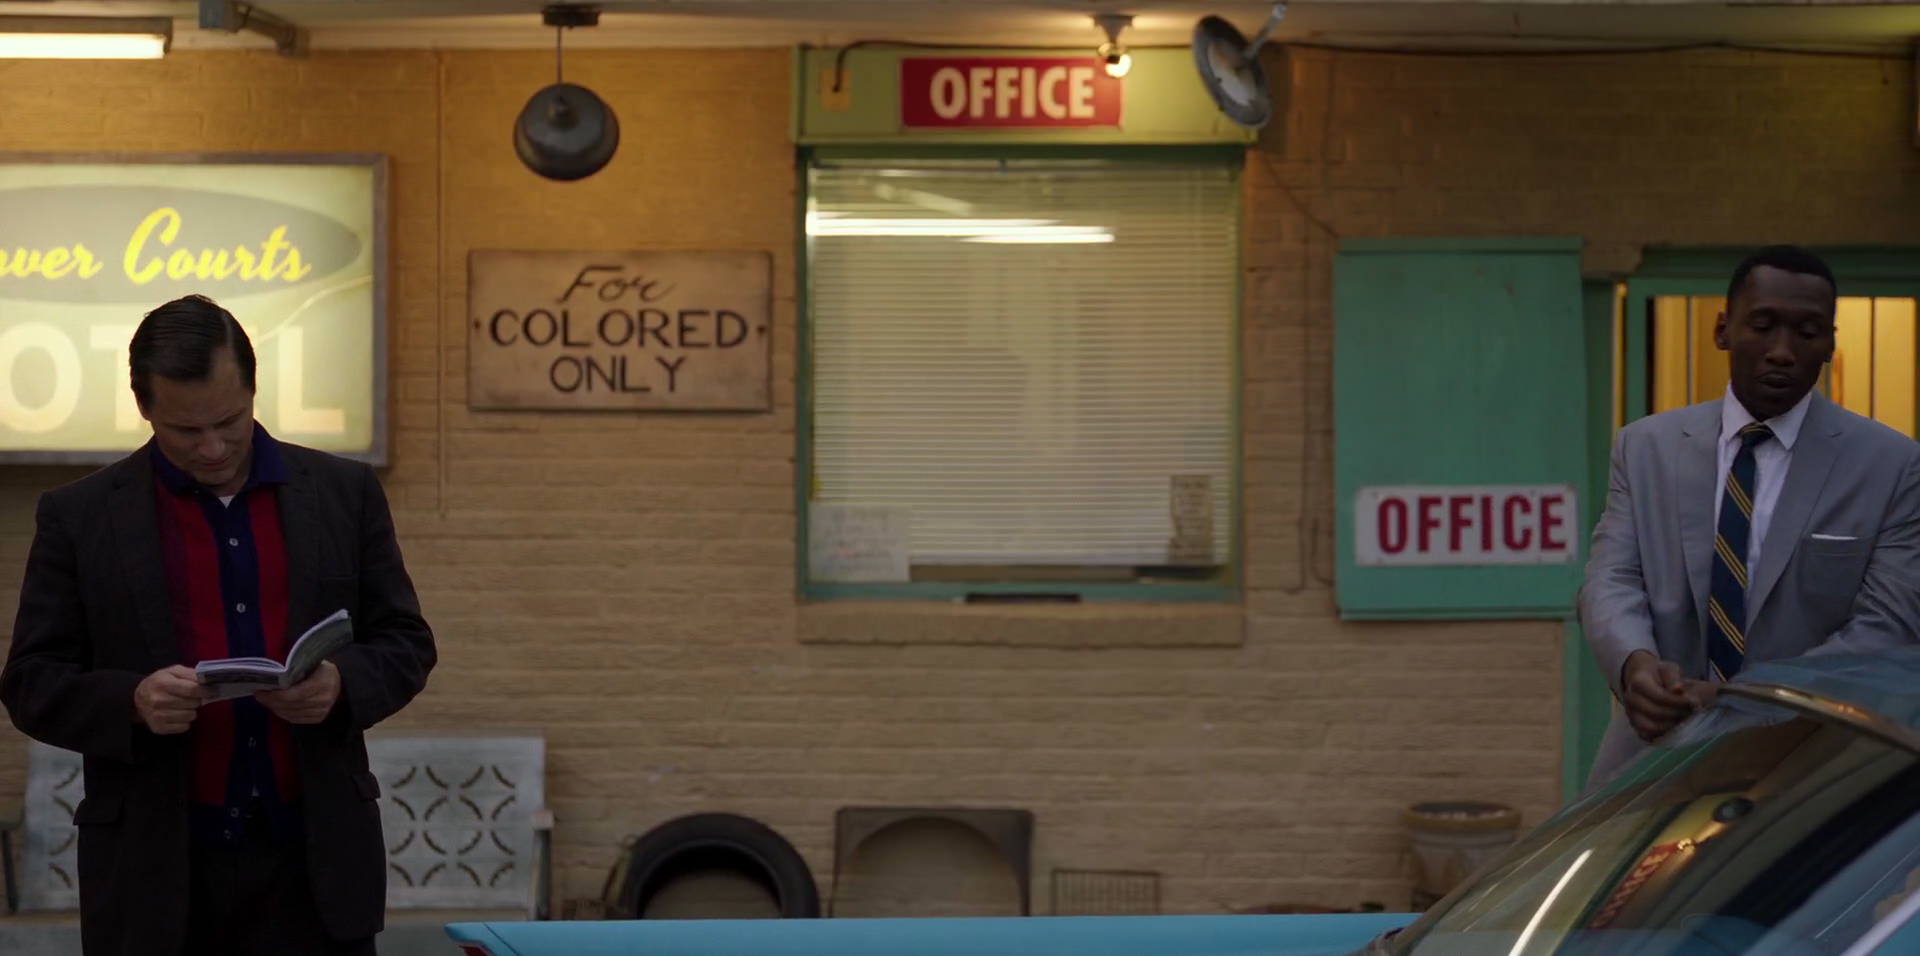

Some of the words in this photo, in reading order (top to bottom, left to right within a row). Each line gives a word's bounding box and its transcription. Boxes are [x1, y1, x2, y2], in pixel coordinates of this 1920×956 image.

[929, 65, 1095, 120] OFFICE
[123, 206, 311, 284] Courts
[558, 264, 675, 304] For
[489, 308, 748, 348] COLORED
[0, 321, 346, 433] OTL
[549, 355, 686, 393] ONLY
[1378, 494, 1567, 553] OFFICE
